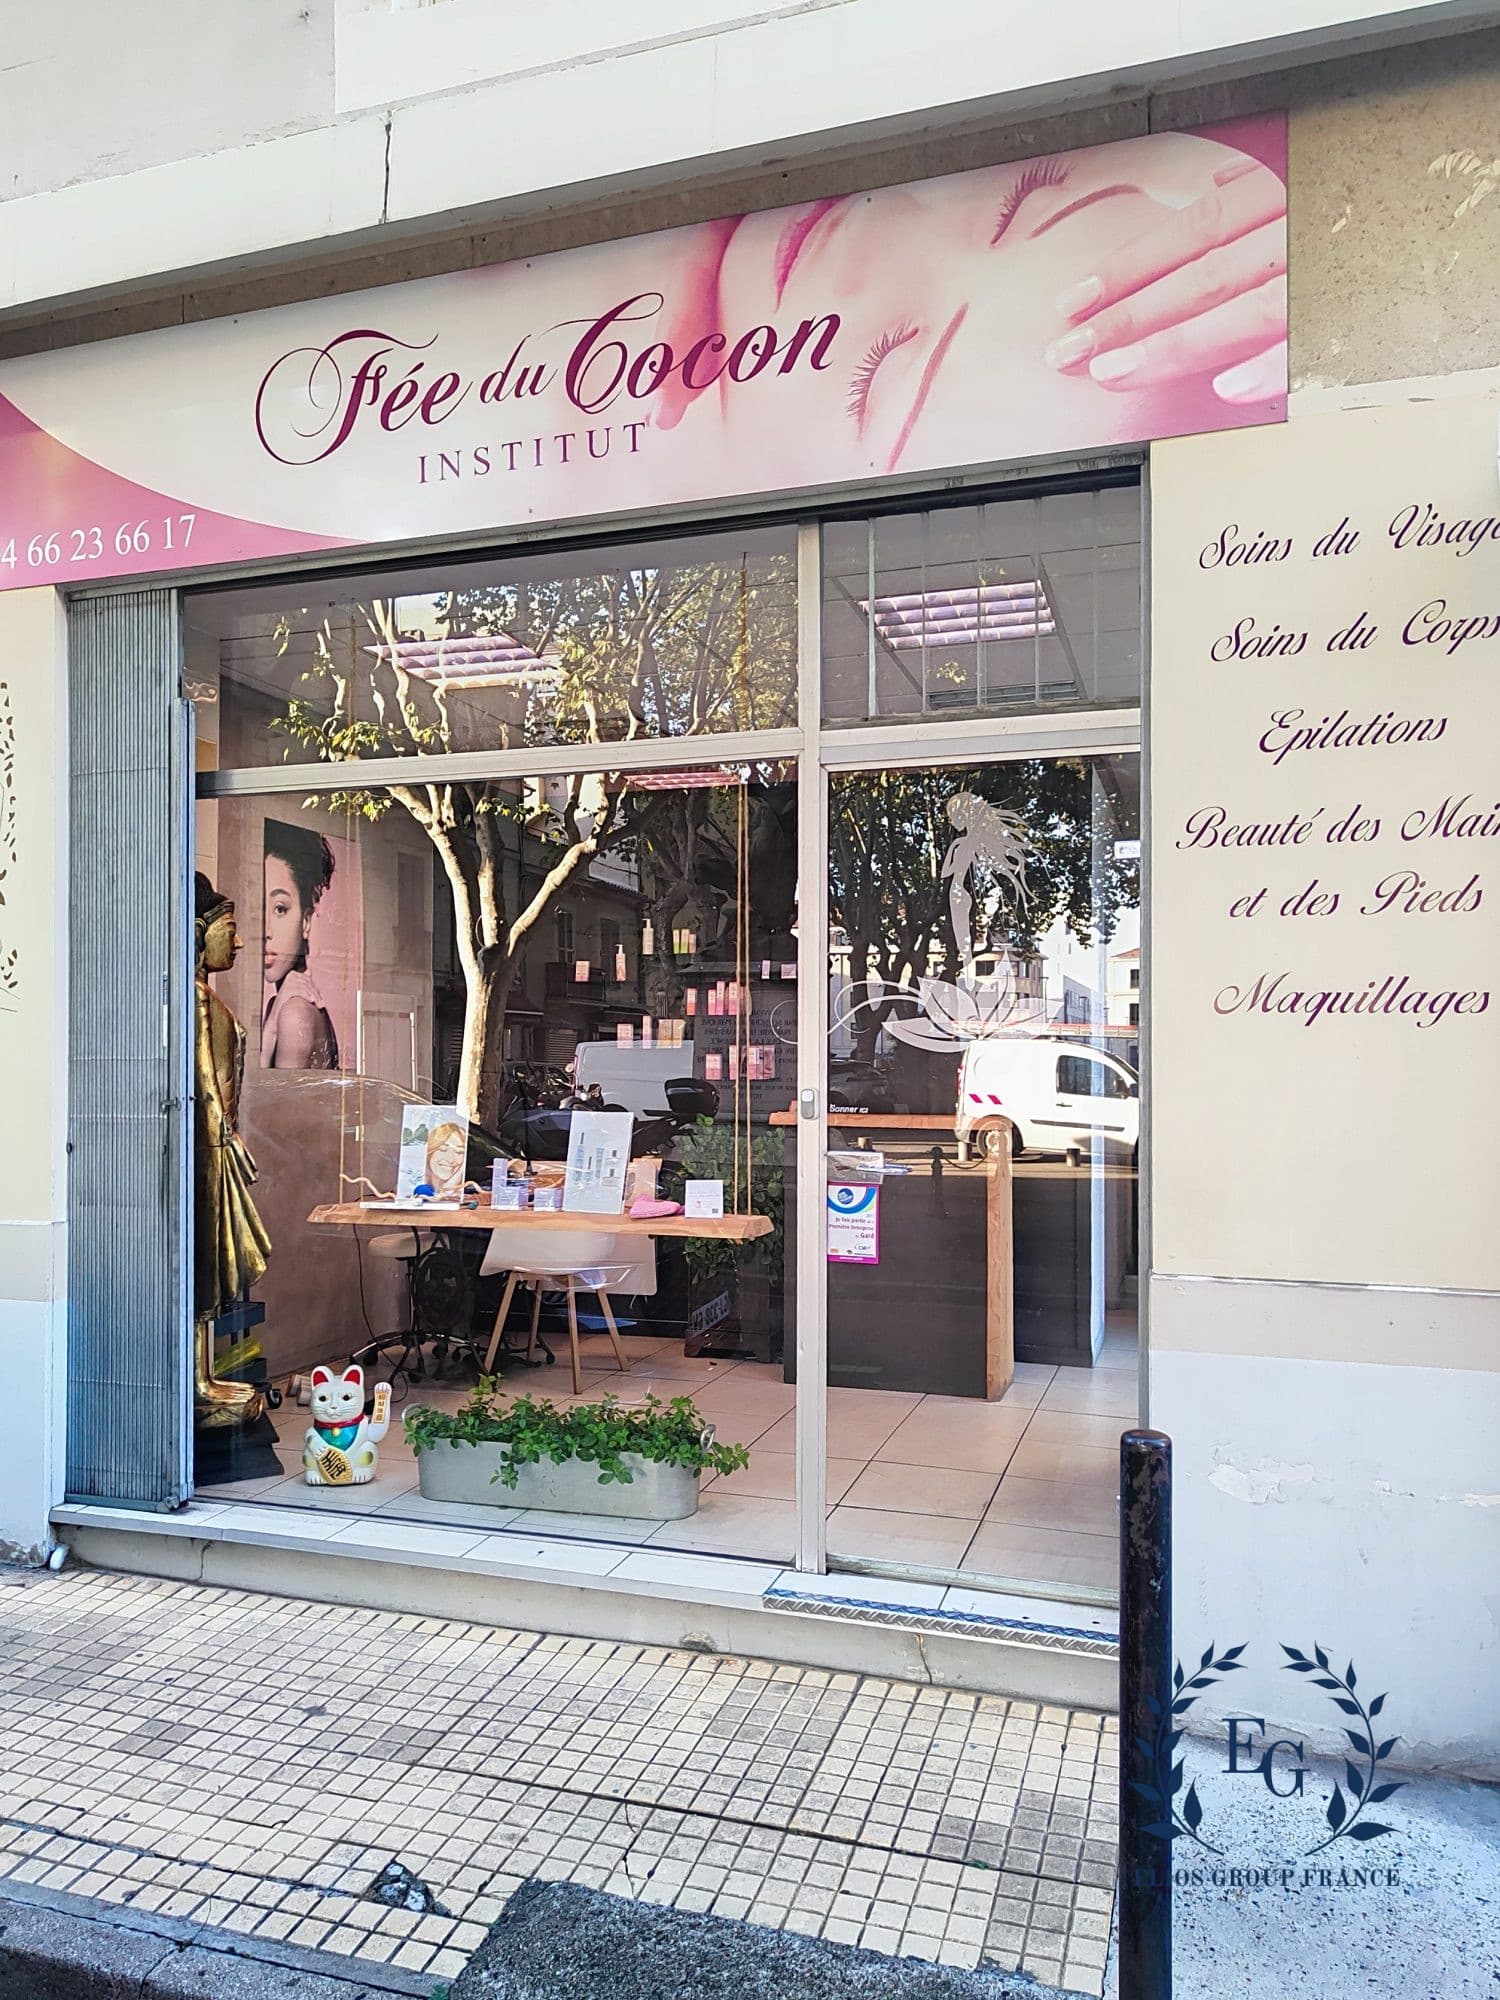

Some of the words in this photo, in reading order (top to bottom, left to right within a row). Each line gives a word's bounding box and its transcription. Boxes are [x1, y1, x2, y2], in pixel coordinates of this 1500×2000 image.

[256, 330, 472, 466] Fée
[480, 334, 557, 404] du
[535, 291, 843, 417] Cocon
[417, 420, 650, 485] INSTITUT
[0, 537, 18, 569] 4
[27, 531, 61, 567] 66
[70, 526, 104, 561] 23
[115, 520, 150, 555] 66
[163, 514, 196, 549] 17
[1199, 524, 1294, 570] Soins
[1312, 517, 1361, 558] du
[1210, 617, 1308, 663] Soins
[1326, 611, 1379, 652] du
[1402, 599, 1500, 655] Corps
[1258, 709, 1448, 765] Epilations
[1175, 806, 1325, 850] Beauté
[1326, 804, 1381, 842] des
[1229, 886, 1269, 919] et
[1280, 879, 1341, 916] des
[1360, 870, 1483, 916] Pieds
[1213, 969, 1492, 1029] Maquillages
